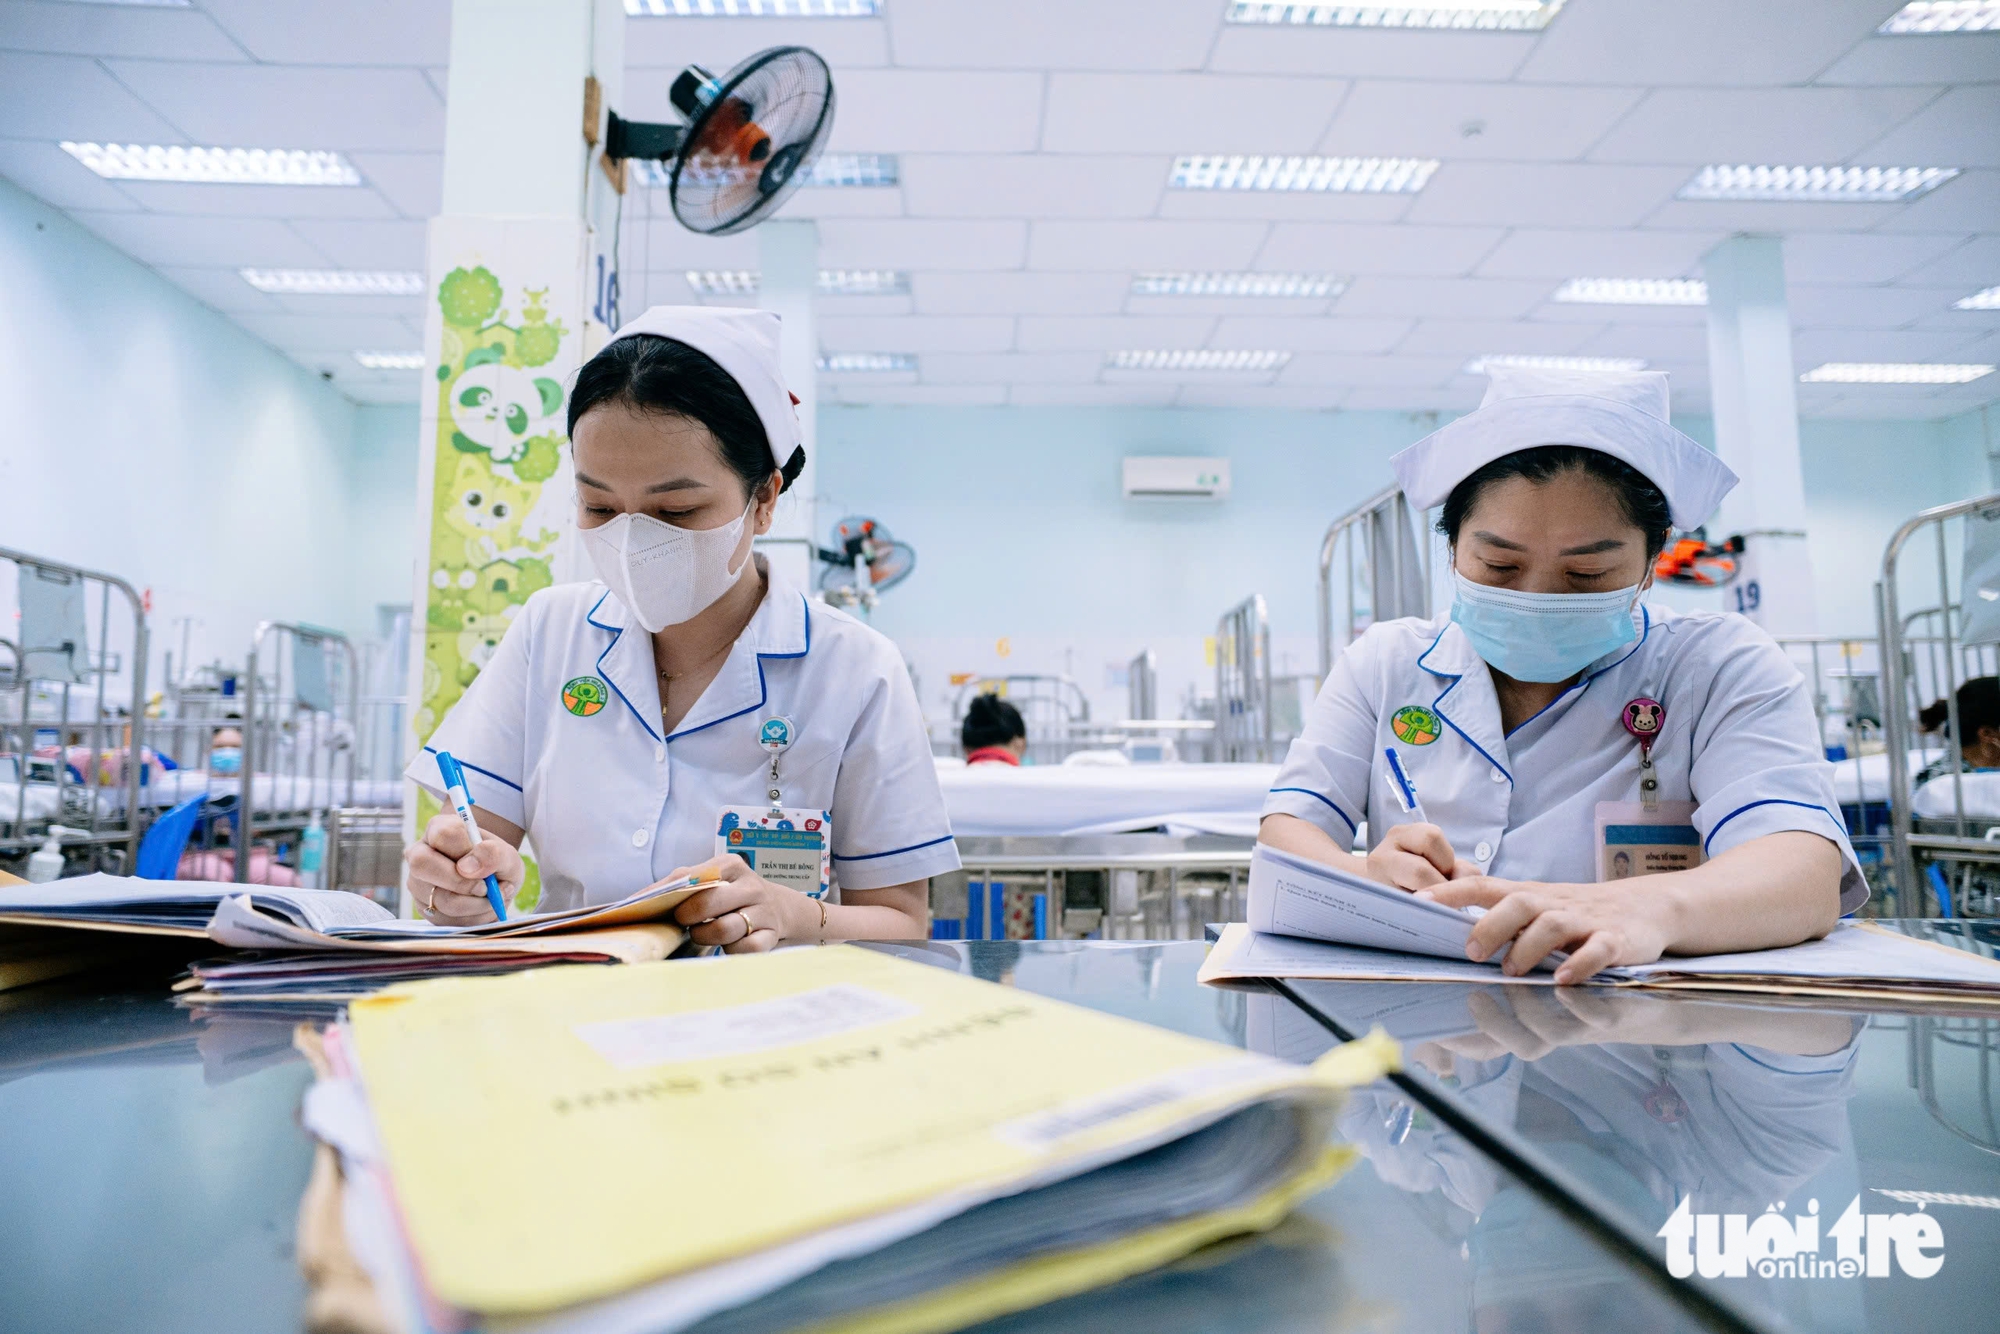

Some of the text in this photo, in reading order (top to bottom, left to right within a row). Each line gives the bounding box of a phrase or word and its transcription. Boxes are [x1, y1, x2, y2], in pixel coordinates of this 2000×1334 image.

[1735, 581, 1760, 612] 19
[996, 637, 1010, 659] 6
[761, 861, 777, 869] TRẦN
